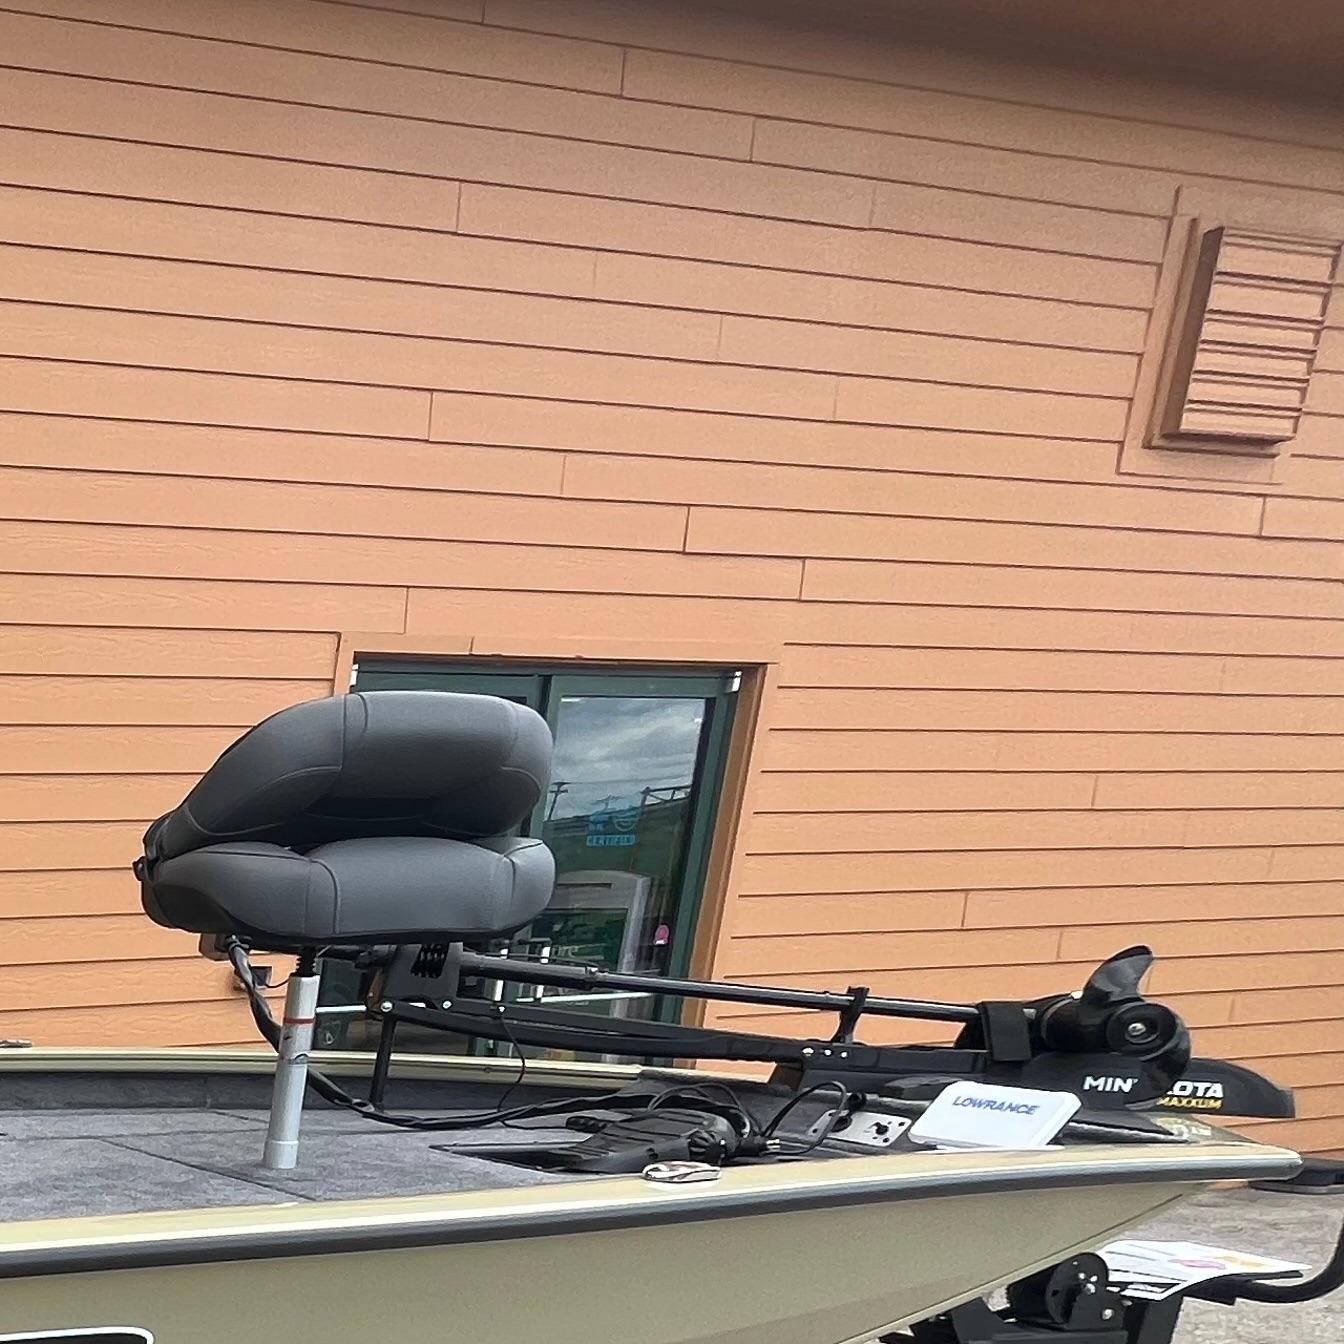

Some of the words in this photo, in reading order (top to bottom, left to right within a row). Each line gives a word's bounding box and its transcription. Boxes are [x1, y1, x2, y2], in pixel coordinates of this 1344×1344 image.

[1082, 1075, 1139, 1094] MIN
[1166, 1080, 1224, 1099] OTA
[952, 1095, 1041, 1117] LOWRANCE
